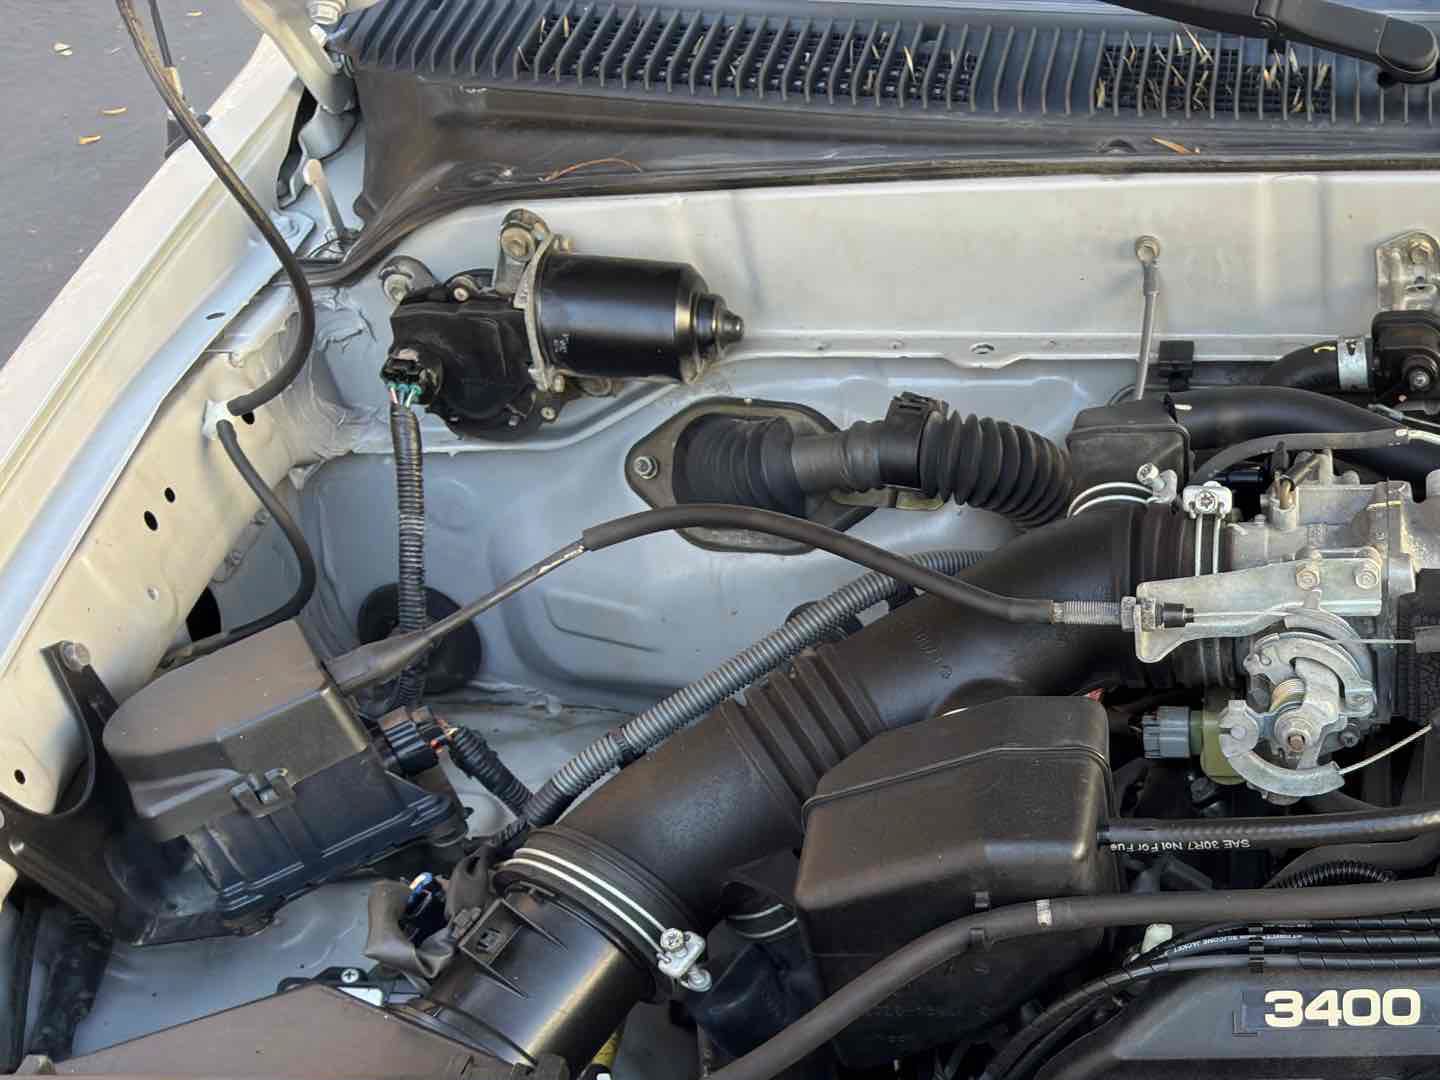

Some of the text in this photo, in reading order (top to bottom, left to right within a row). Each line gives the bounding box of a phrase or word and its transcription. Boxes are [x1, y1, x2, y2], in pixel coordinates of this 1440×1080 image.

[1138, 842, 1158, 853] For
[1161, 841, 1183, 851] Not
[1188, 840, 1219, 850] 30R7
[1222, 839, 1250, 849] SAE
[1264, 988, 1421, 1027] 3400
